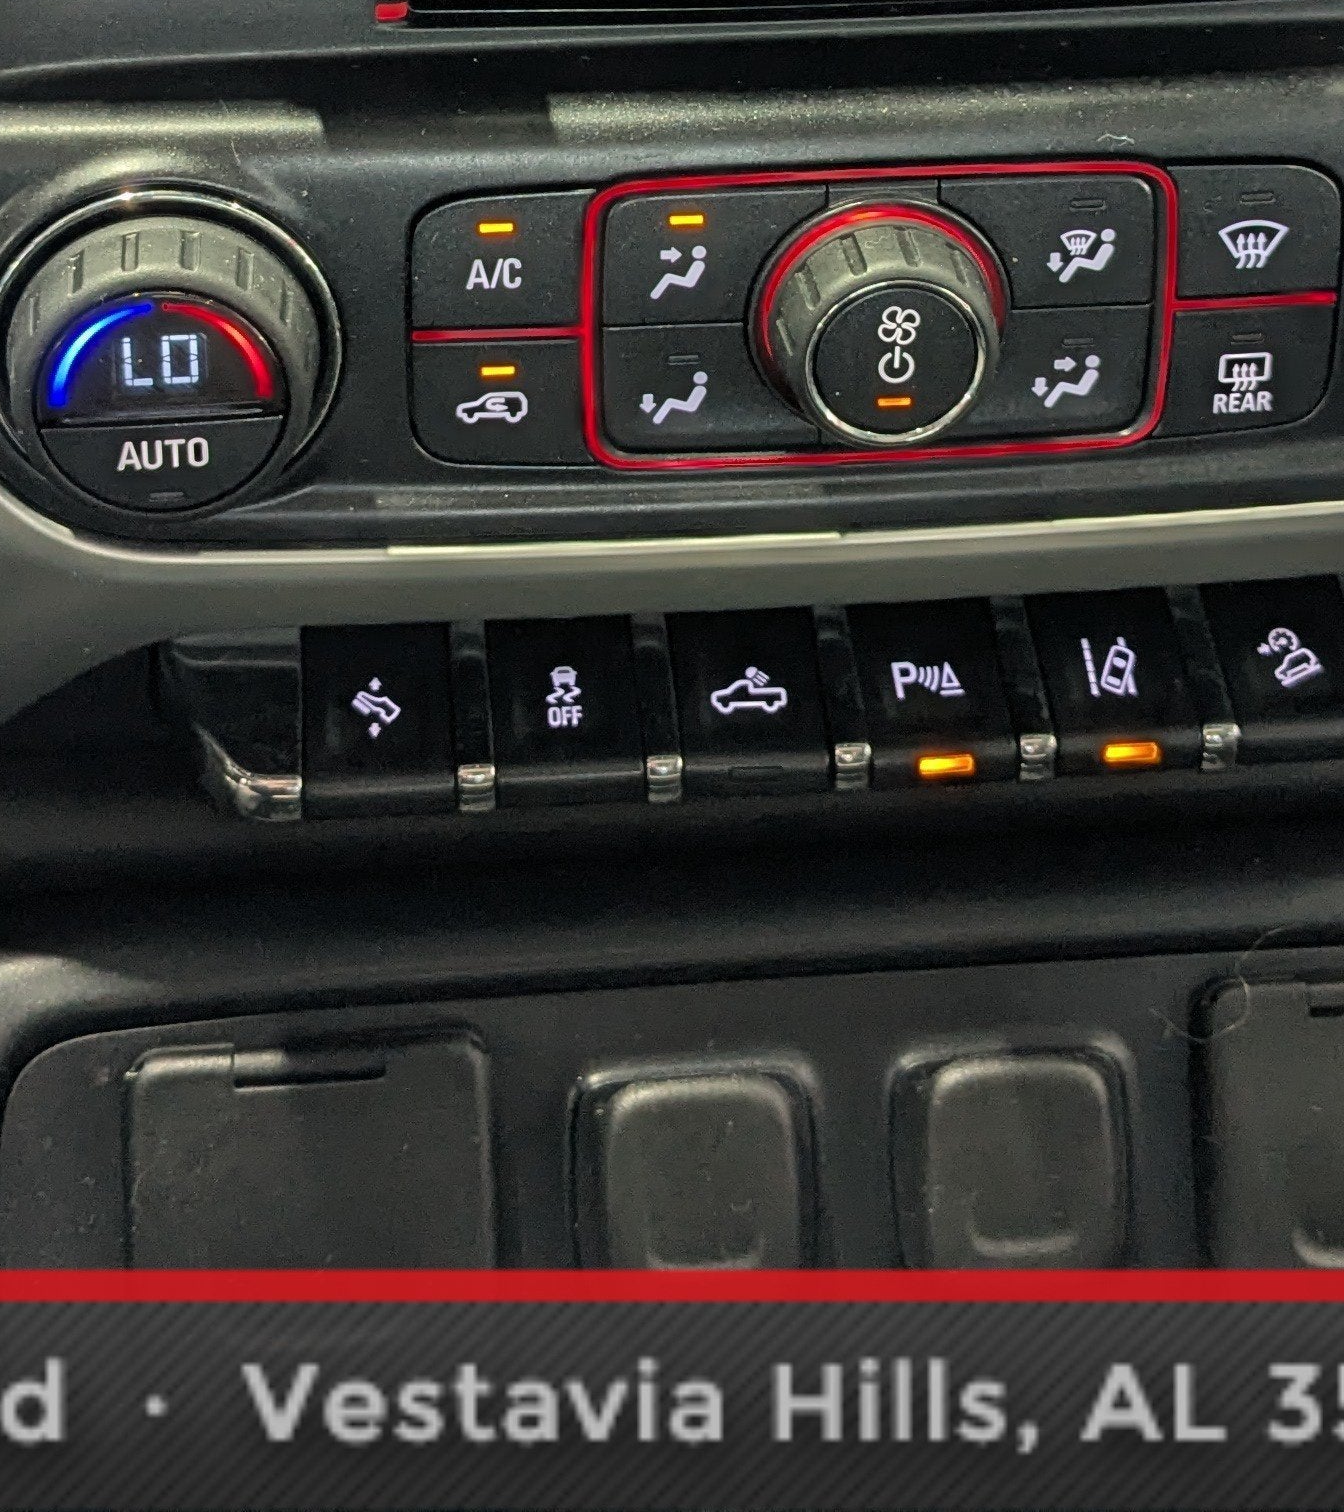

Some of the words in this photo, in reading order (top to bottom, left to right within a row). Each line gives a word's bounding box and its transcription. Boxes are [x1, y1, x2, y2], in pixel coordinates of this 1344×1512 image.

[464, 256, 524, 292] A/C
[119, 332, 201, 388] LO
[1211, 389, 1274, 415] REAR
[116, 436, 210, 473] AUTO
[545, 701, 584, 729] OFF
